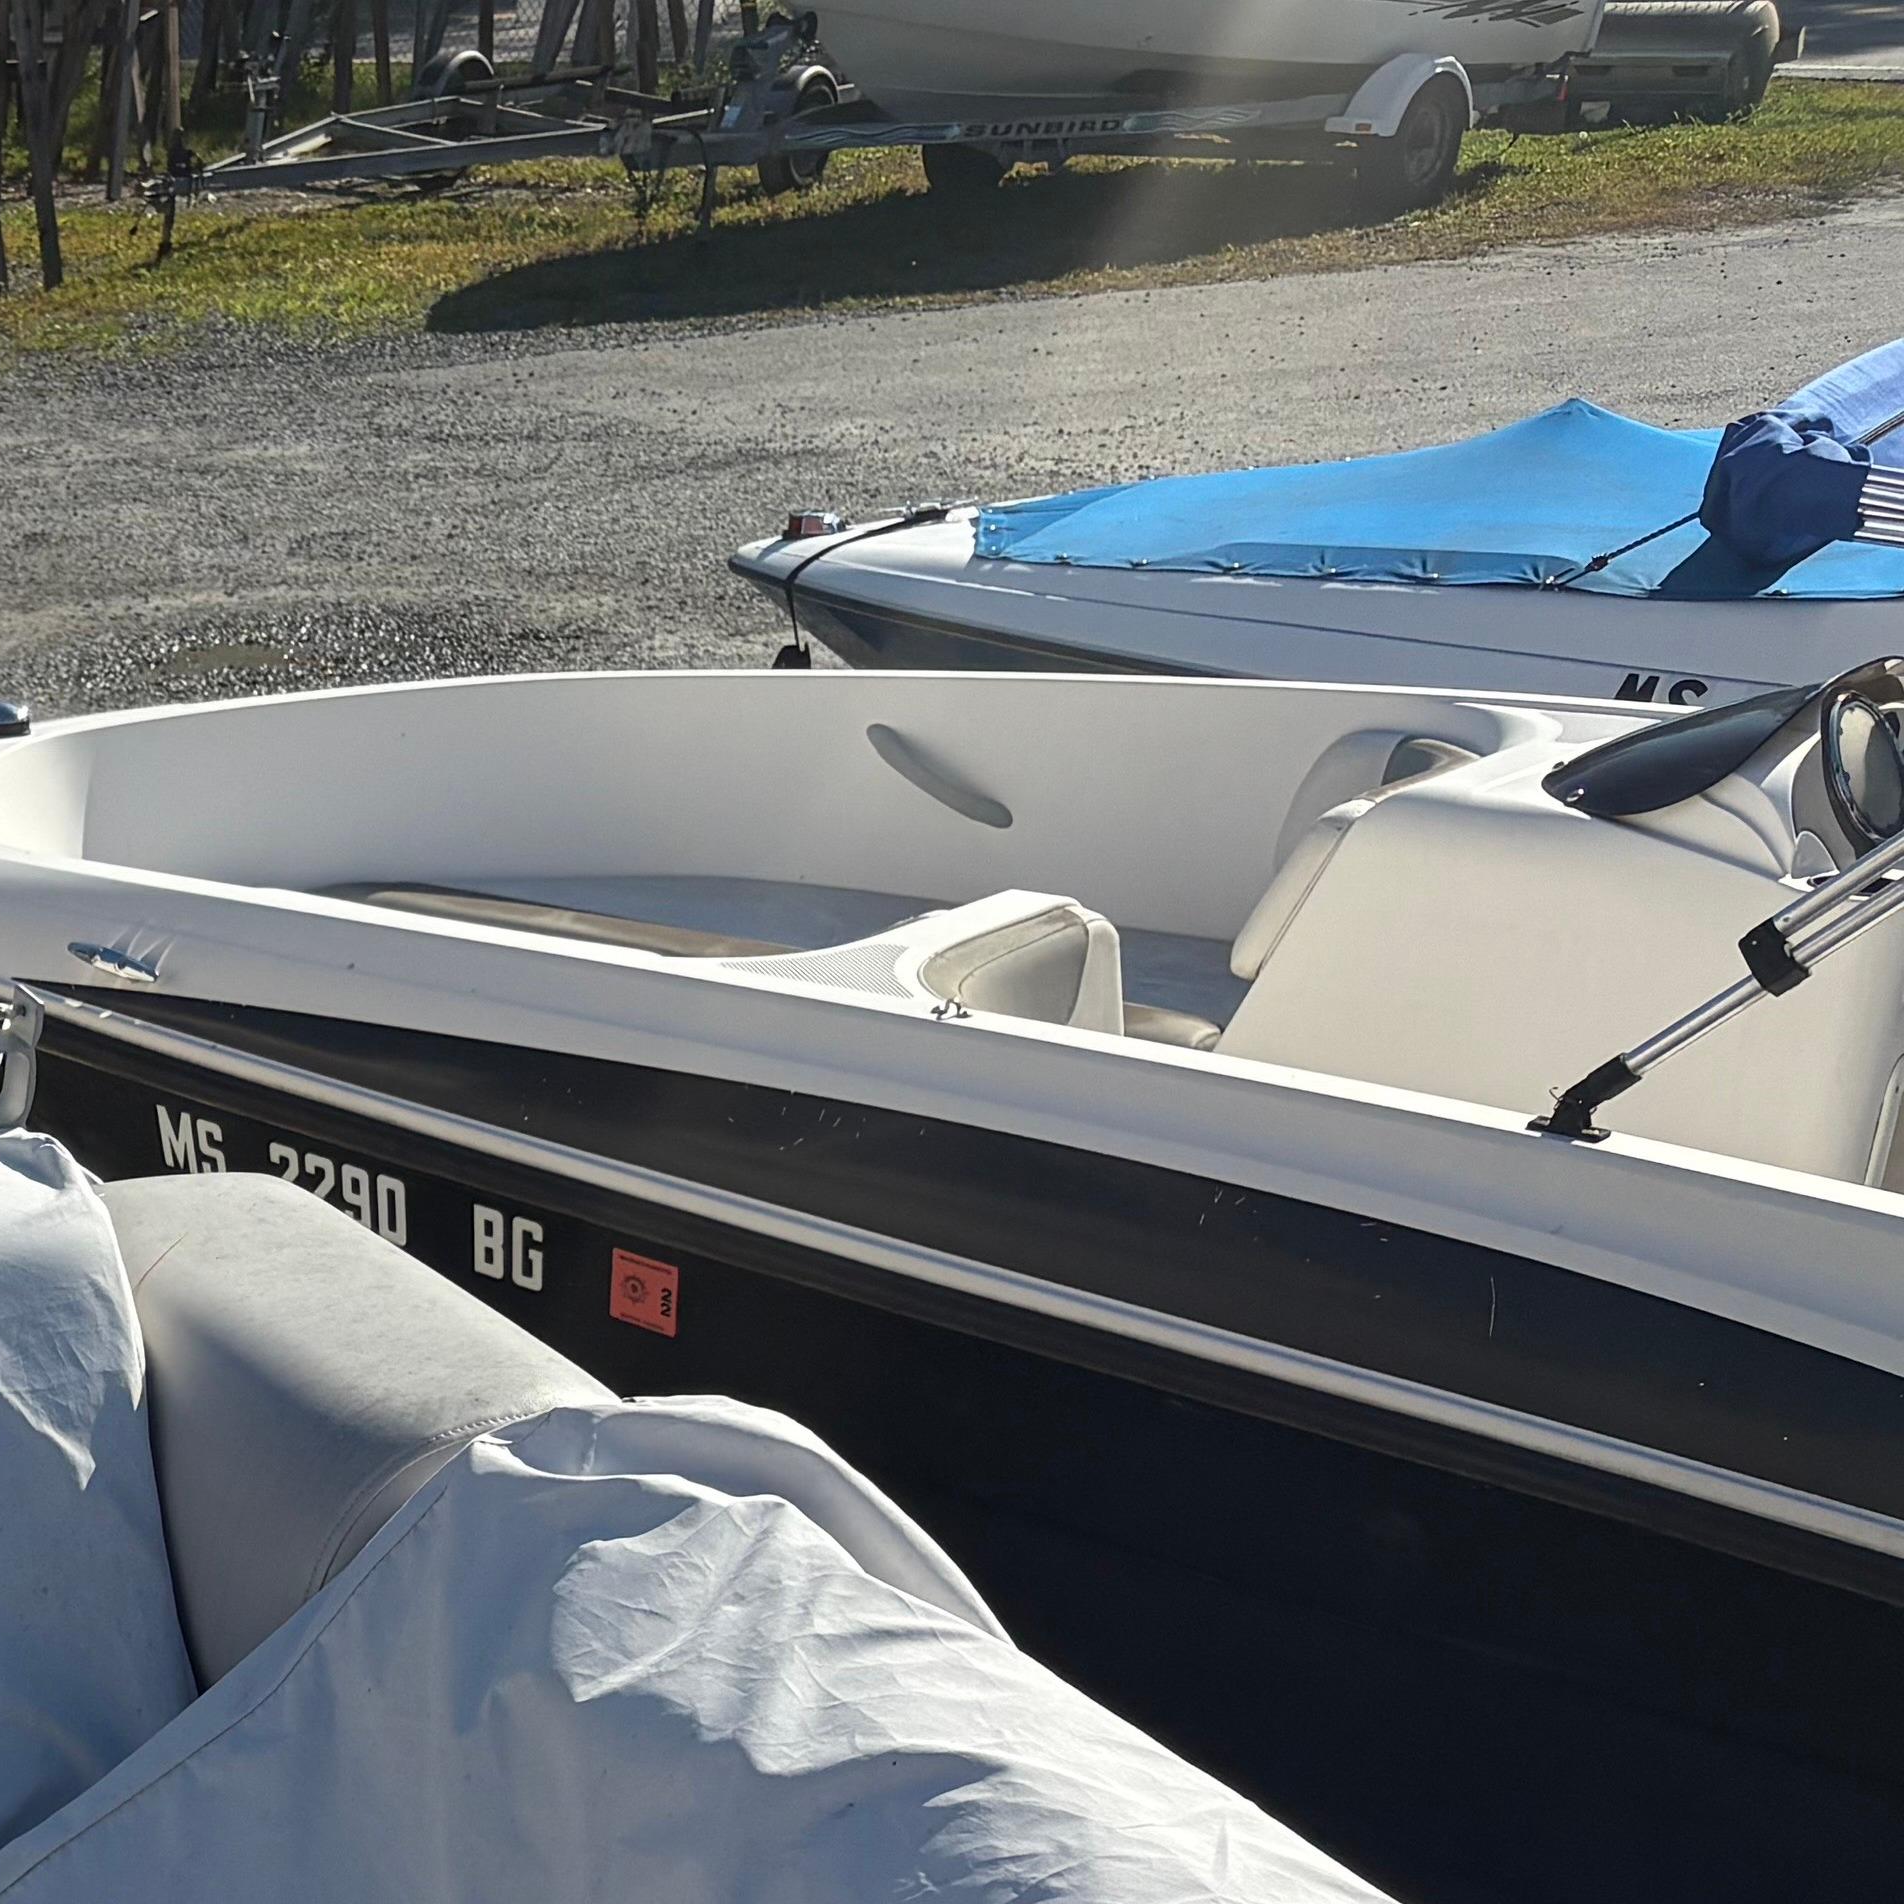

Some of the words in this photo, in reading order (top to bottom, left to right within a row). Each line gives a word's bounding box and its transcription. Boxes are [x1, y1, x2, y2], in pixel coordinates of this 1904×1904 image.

[964, 119, 1122, 138] SUNBIRD
[155, 1104, 227, 1174] MS
[473, 1203, 544, 1292] BG
[660, 1287, 672, 1318] 22
